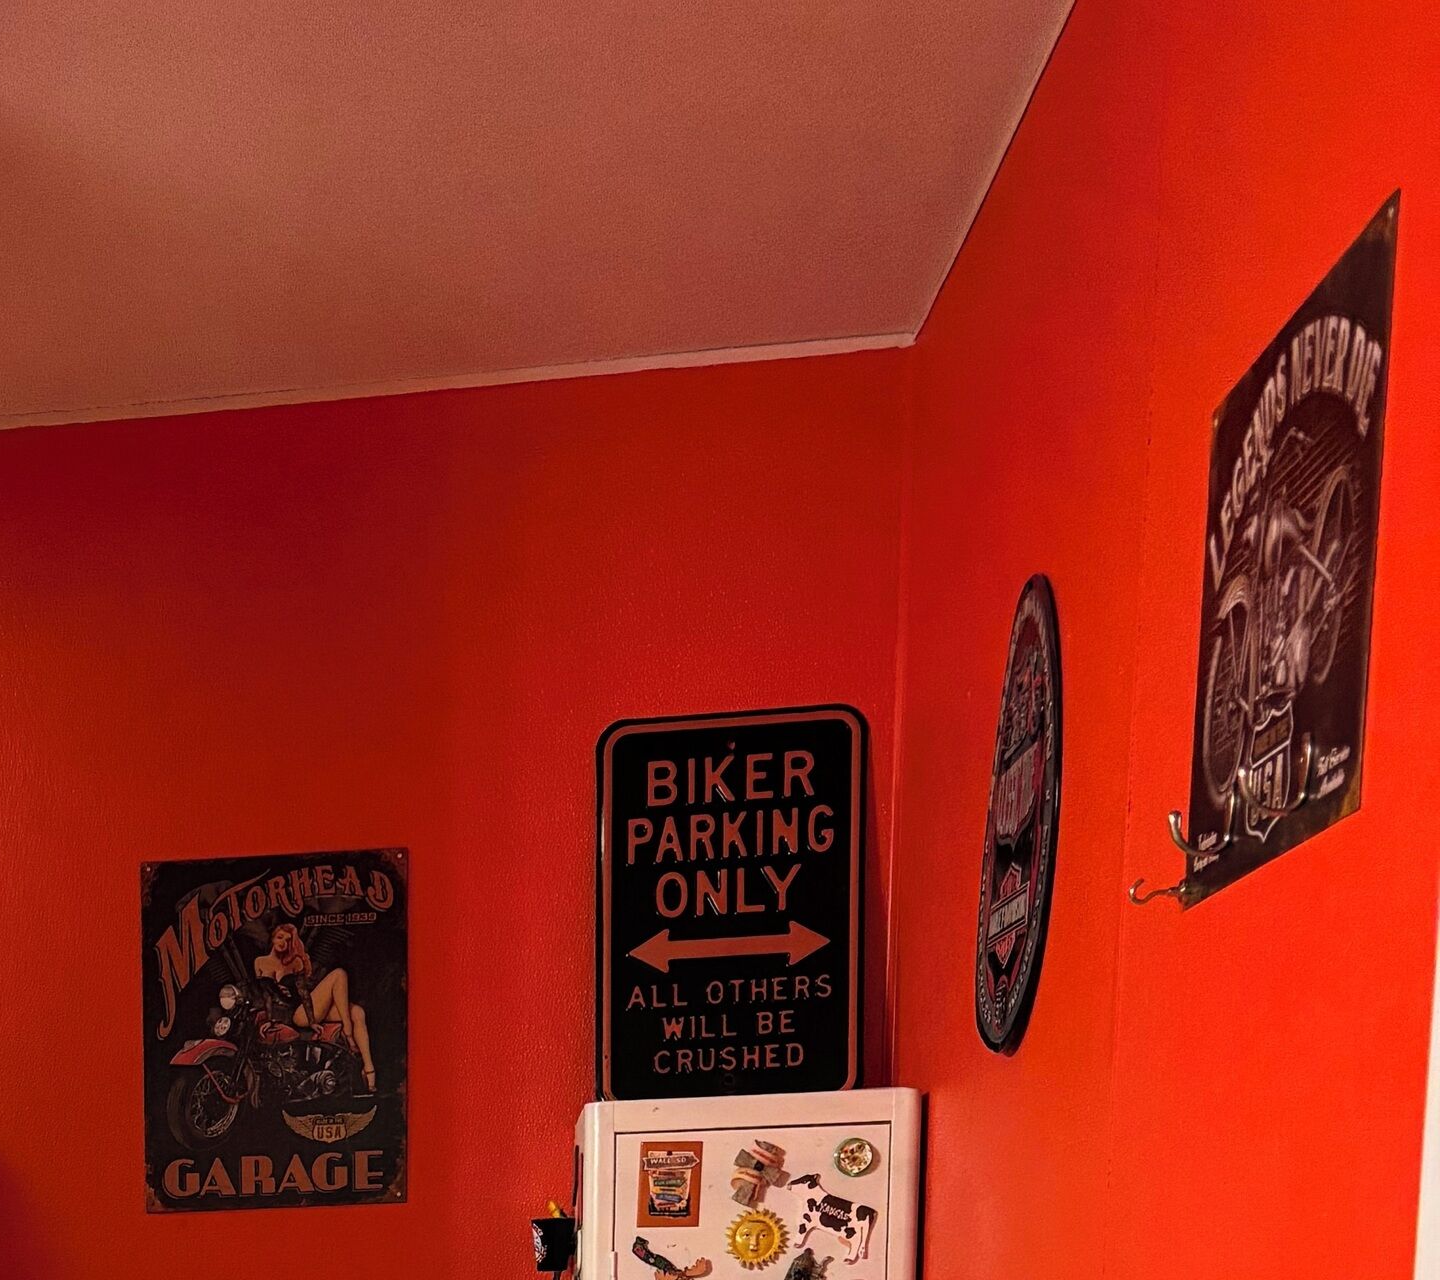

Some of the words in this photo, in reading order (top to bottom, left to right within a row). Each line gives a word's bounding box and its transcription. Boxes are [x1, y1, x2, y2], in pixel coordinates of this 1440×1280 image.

[1210, 353, 1287, 592] LEGENDS
[1291, 316, 1350, 405] NEVER
[1345, 324, 1382, 440] DIE
[647, 750, 815, 807] BIKER
[626, 805, 834, 865] PARKING
[656, 864, 802, 918] ONLY
[307, 914, 345, 924] SINCE
[155, 865, 395, 1040] MOTORHEAD
[626, 984, 688, 1011] ALL
[706, 975, 832, 1004] OTHERS
[663, 1014, 737, 1041] WILL
[756, 1010, 795, 1035] BE
[654, 1043, 804, 1074] CRUSHED
[317, 1126, 341, 1139] USA
[164, 1151, 385, 1198] GARAGE
